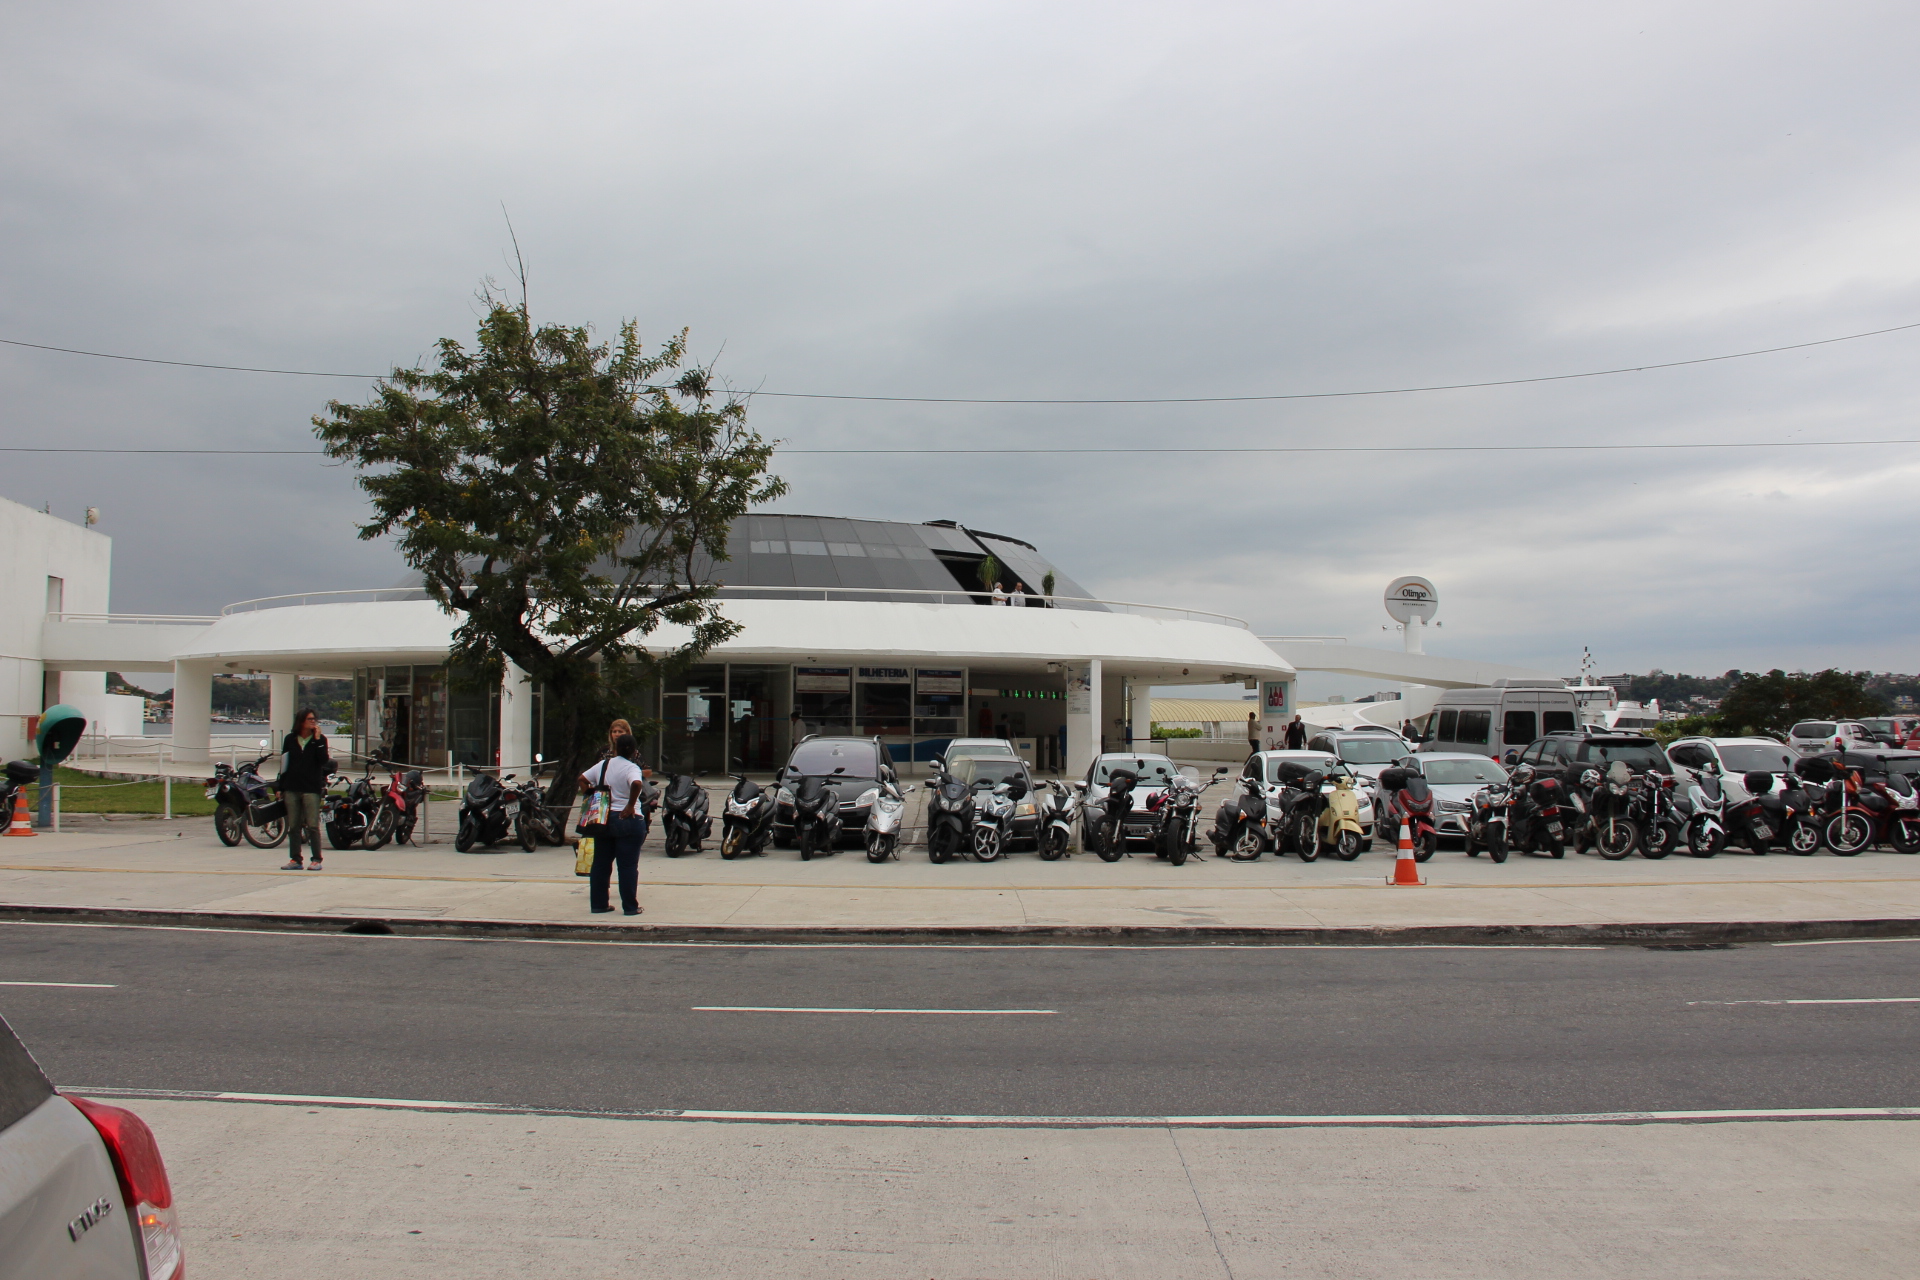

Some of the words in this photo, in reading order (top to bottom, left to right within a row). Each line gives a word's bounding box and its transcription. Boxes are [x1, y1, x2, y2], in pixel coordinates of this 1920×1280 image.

[1402, 588, 1426, 600] Olimpo
[859, 667, 909, 678] BILHETERIA
[68, 1196, 113, 1243] ETIOS
